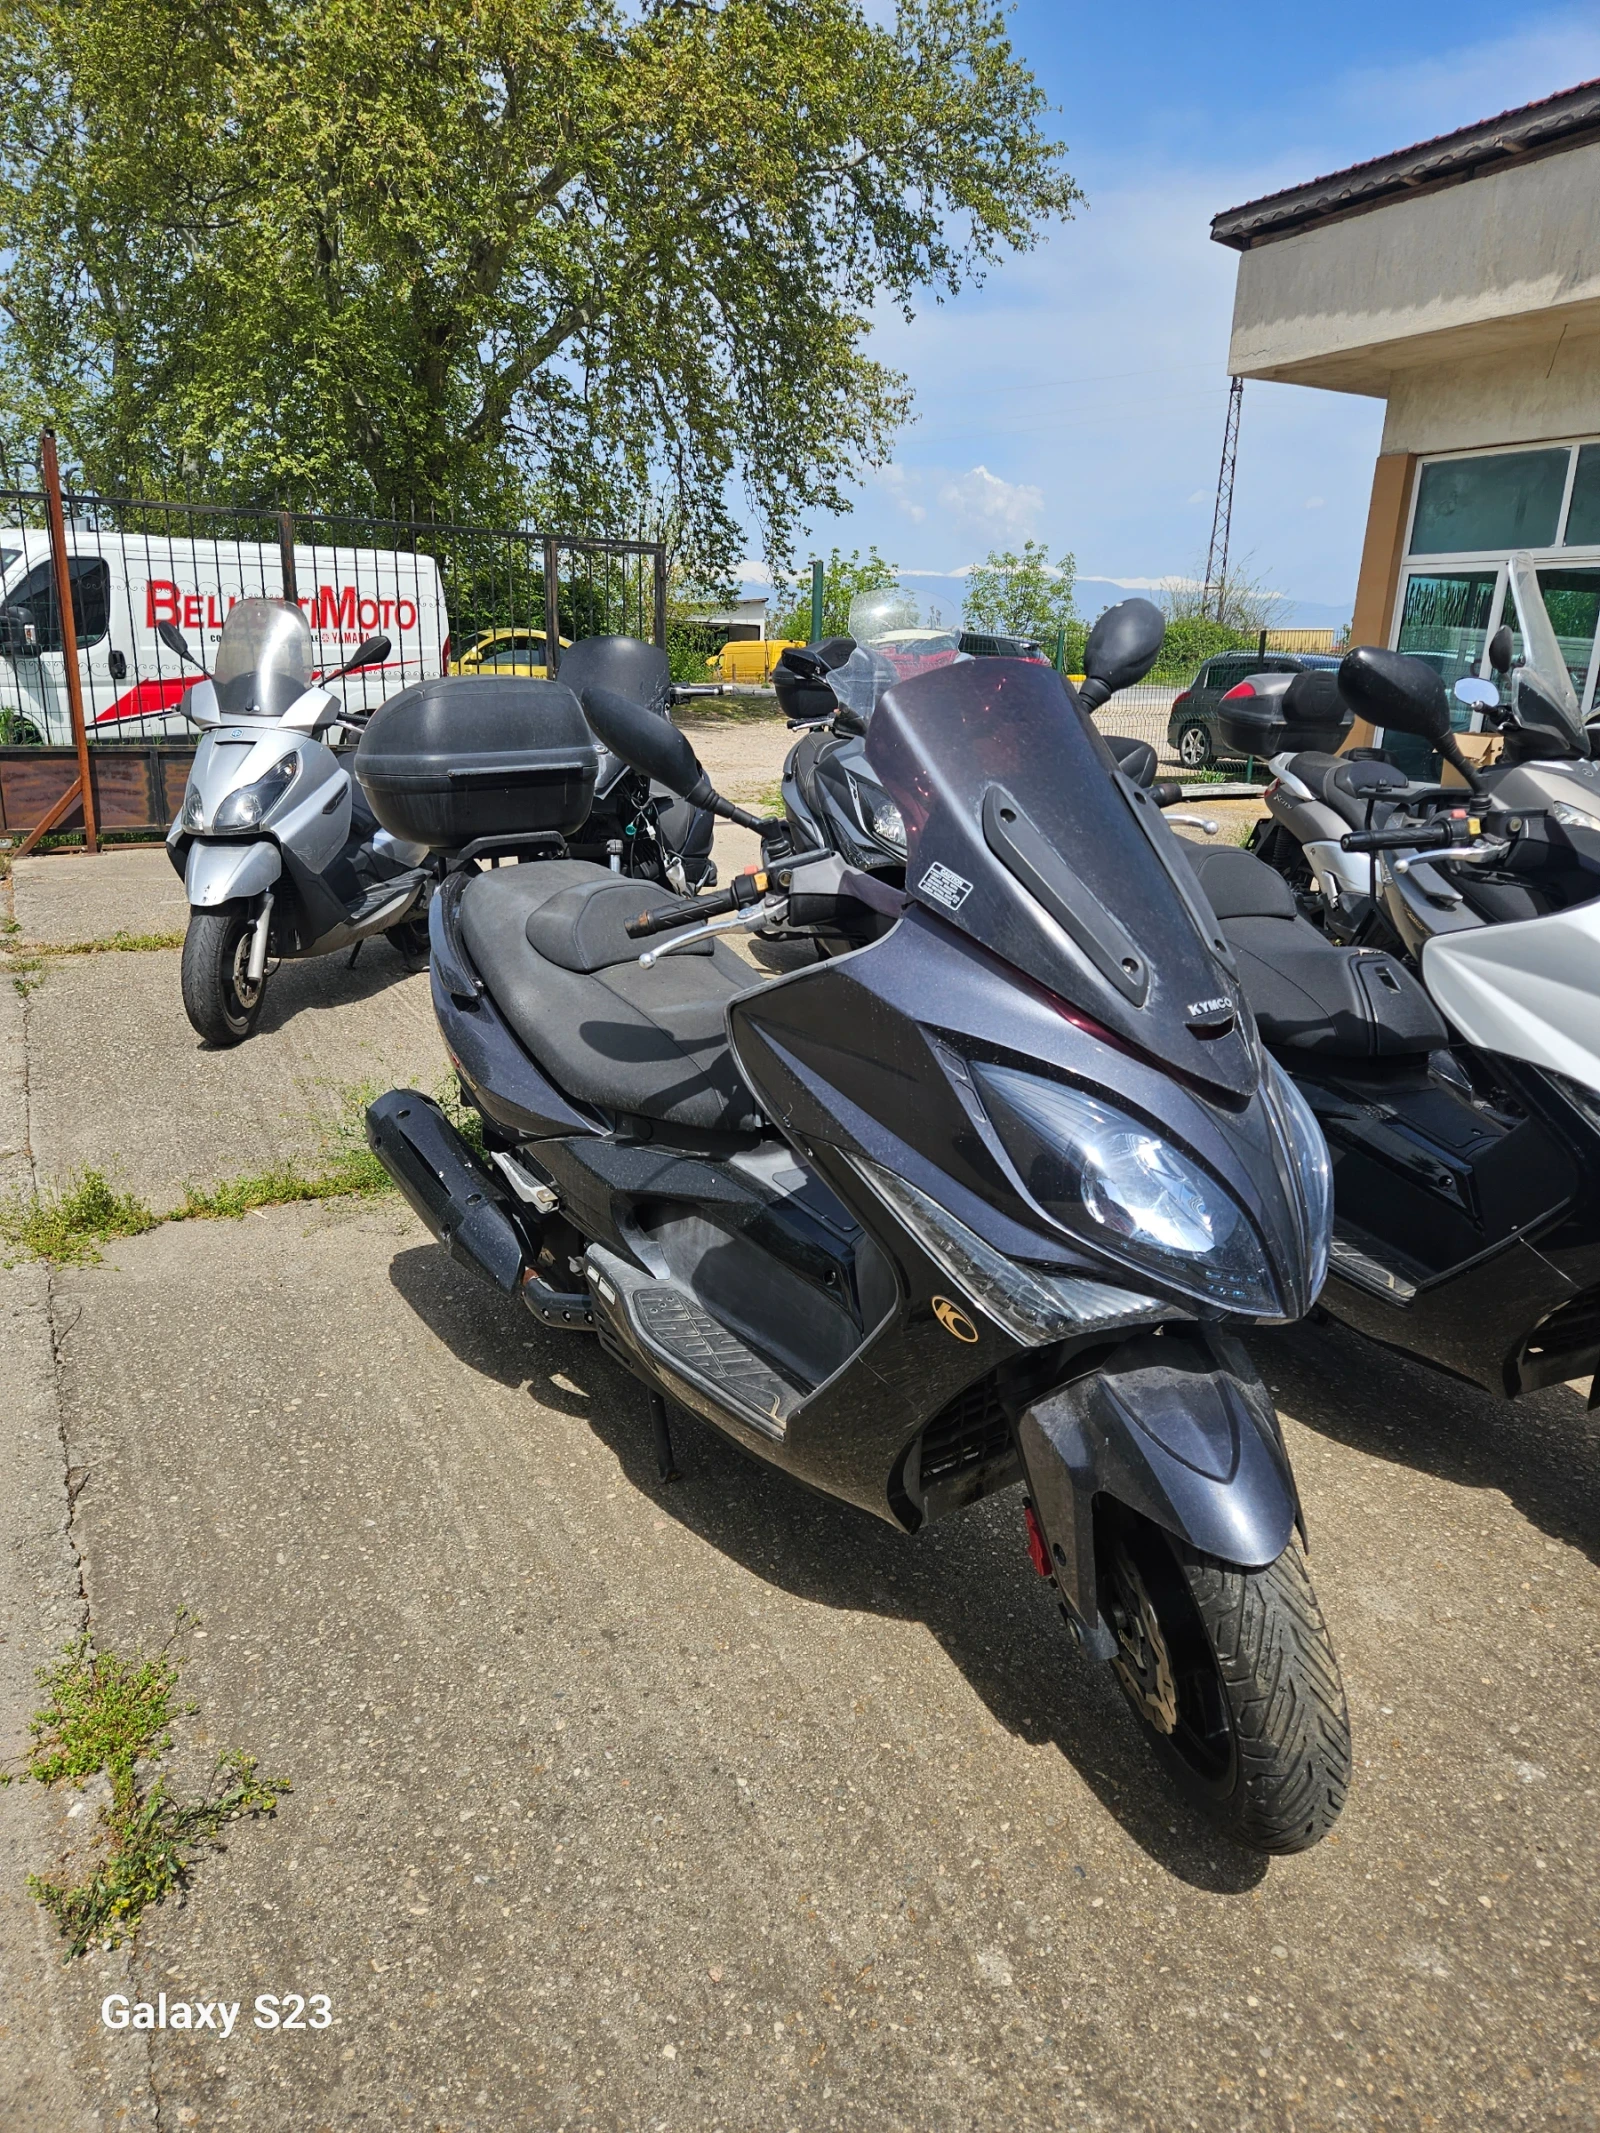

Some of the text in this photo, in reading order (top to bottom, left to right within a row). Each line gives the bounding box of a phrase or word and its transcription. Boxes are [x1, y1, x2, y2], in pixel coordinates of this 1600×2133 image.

[146, 579, 417, 630] BELIMOTO
[940, 868, 964, 887] CAUTION
[1187, 997, 1233, 1017] KYMCO
